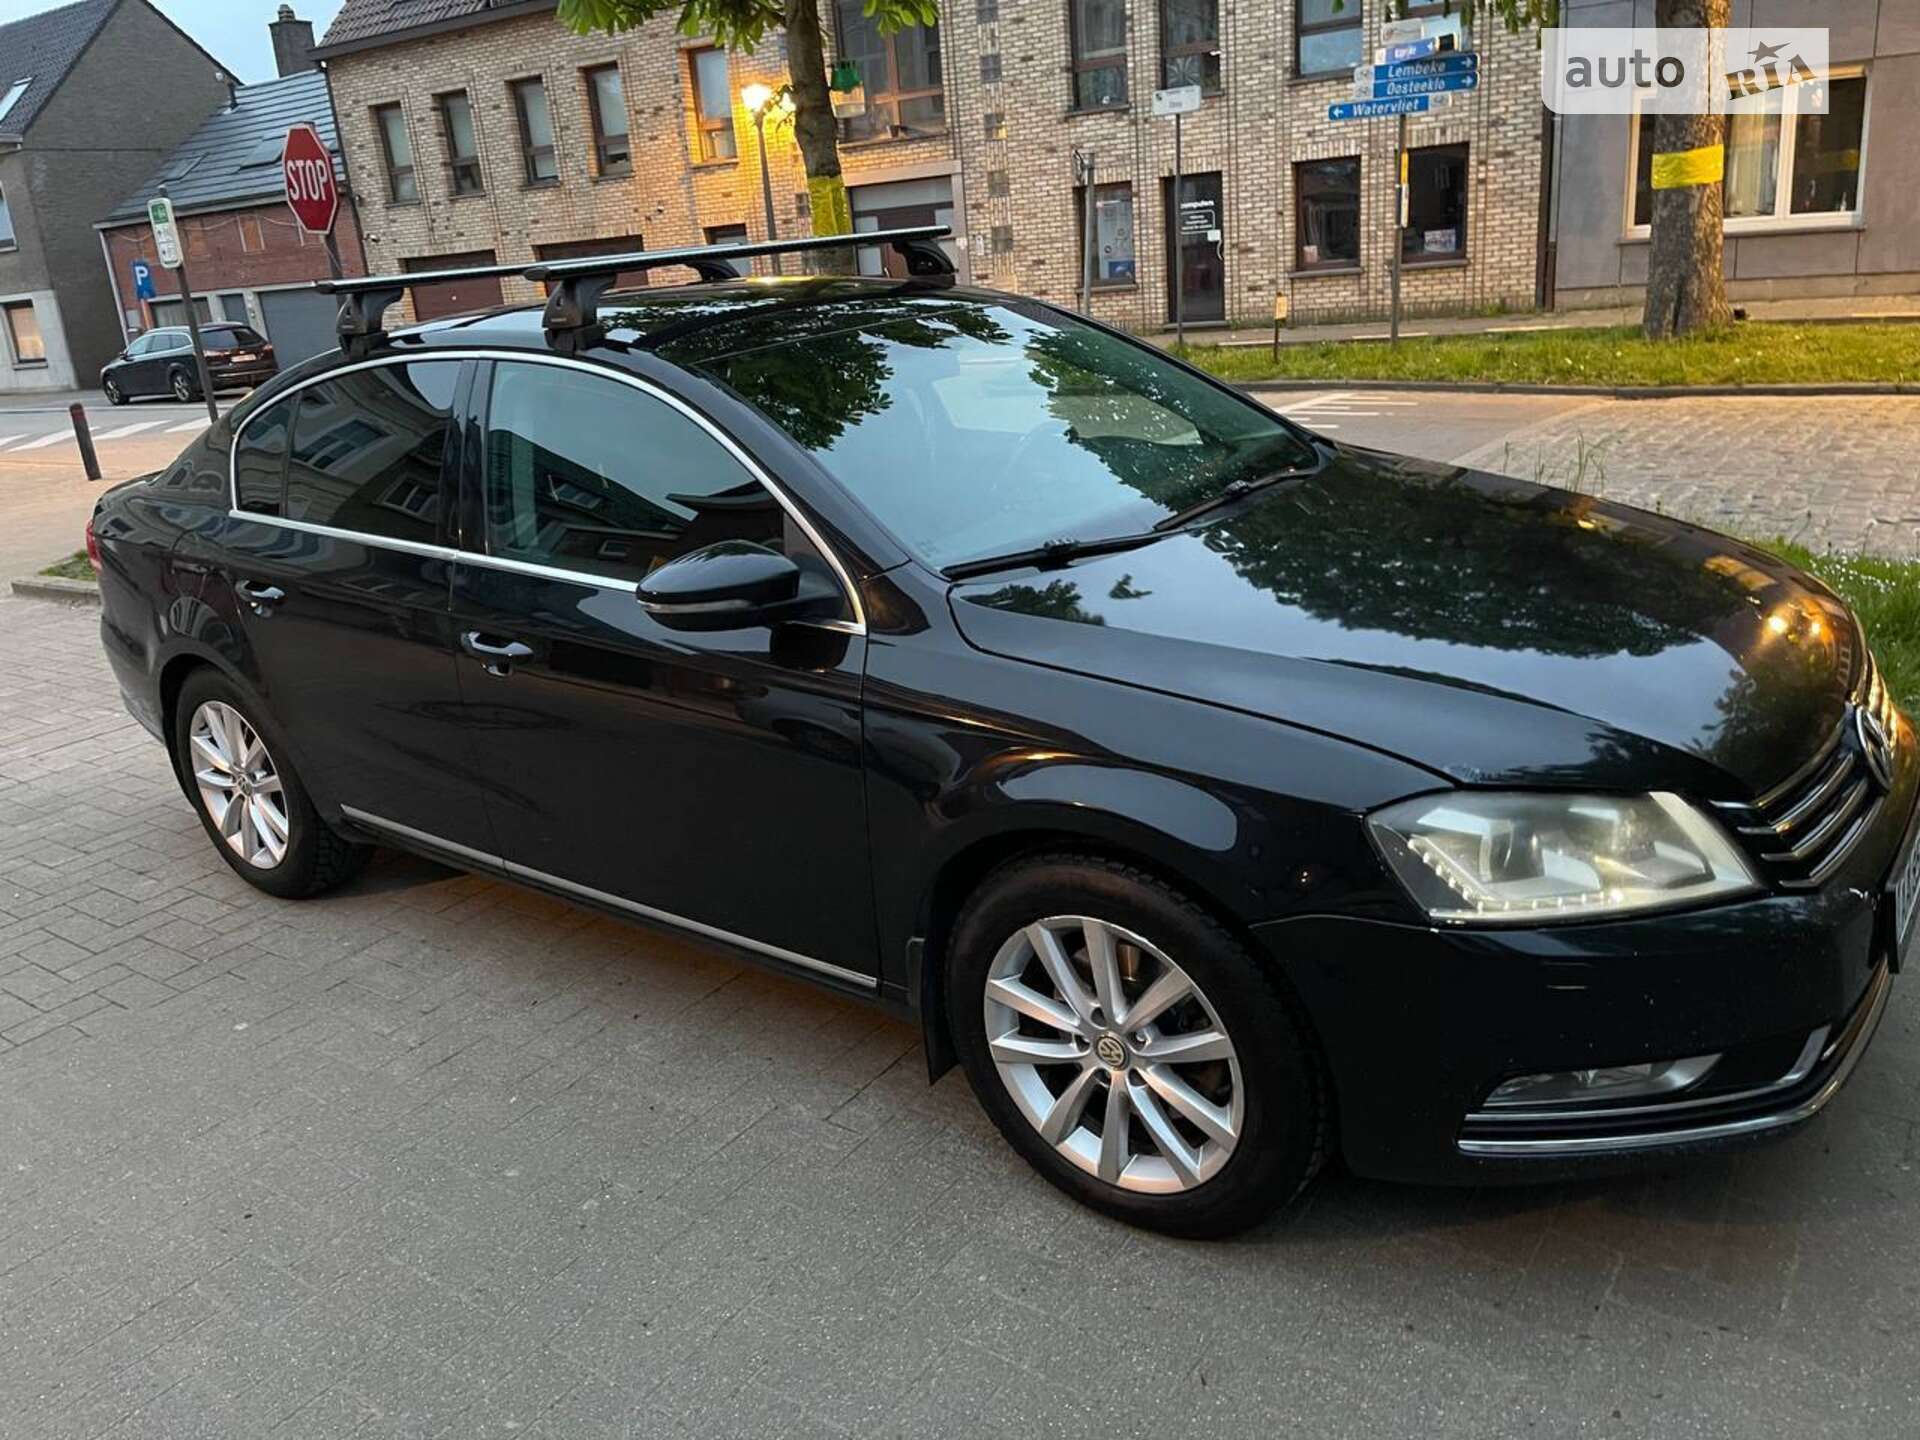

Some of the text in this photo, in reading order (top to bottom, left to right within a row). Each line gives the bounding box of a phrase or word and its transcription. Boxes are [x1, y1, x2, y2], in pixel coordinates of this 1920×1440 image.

[1388, 61, 1446, 78] Lembeke
[1387, 78, 1446, 95] Oosteeklo
[1352, 99, 1419, 115] Watervliet
[286, 159, 328, 201] STOP
[134, 265, 149, 287] P
